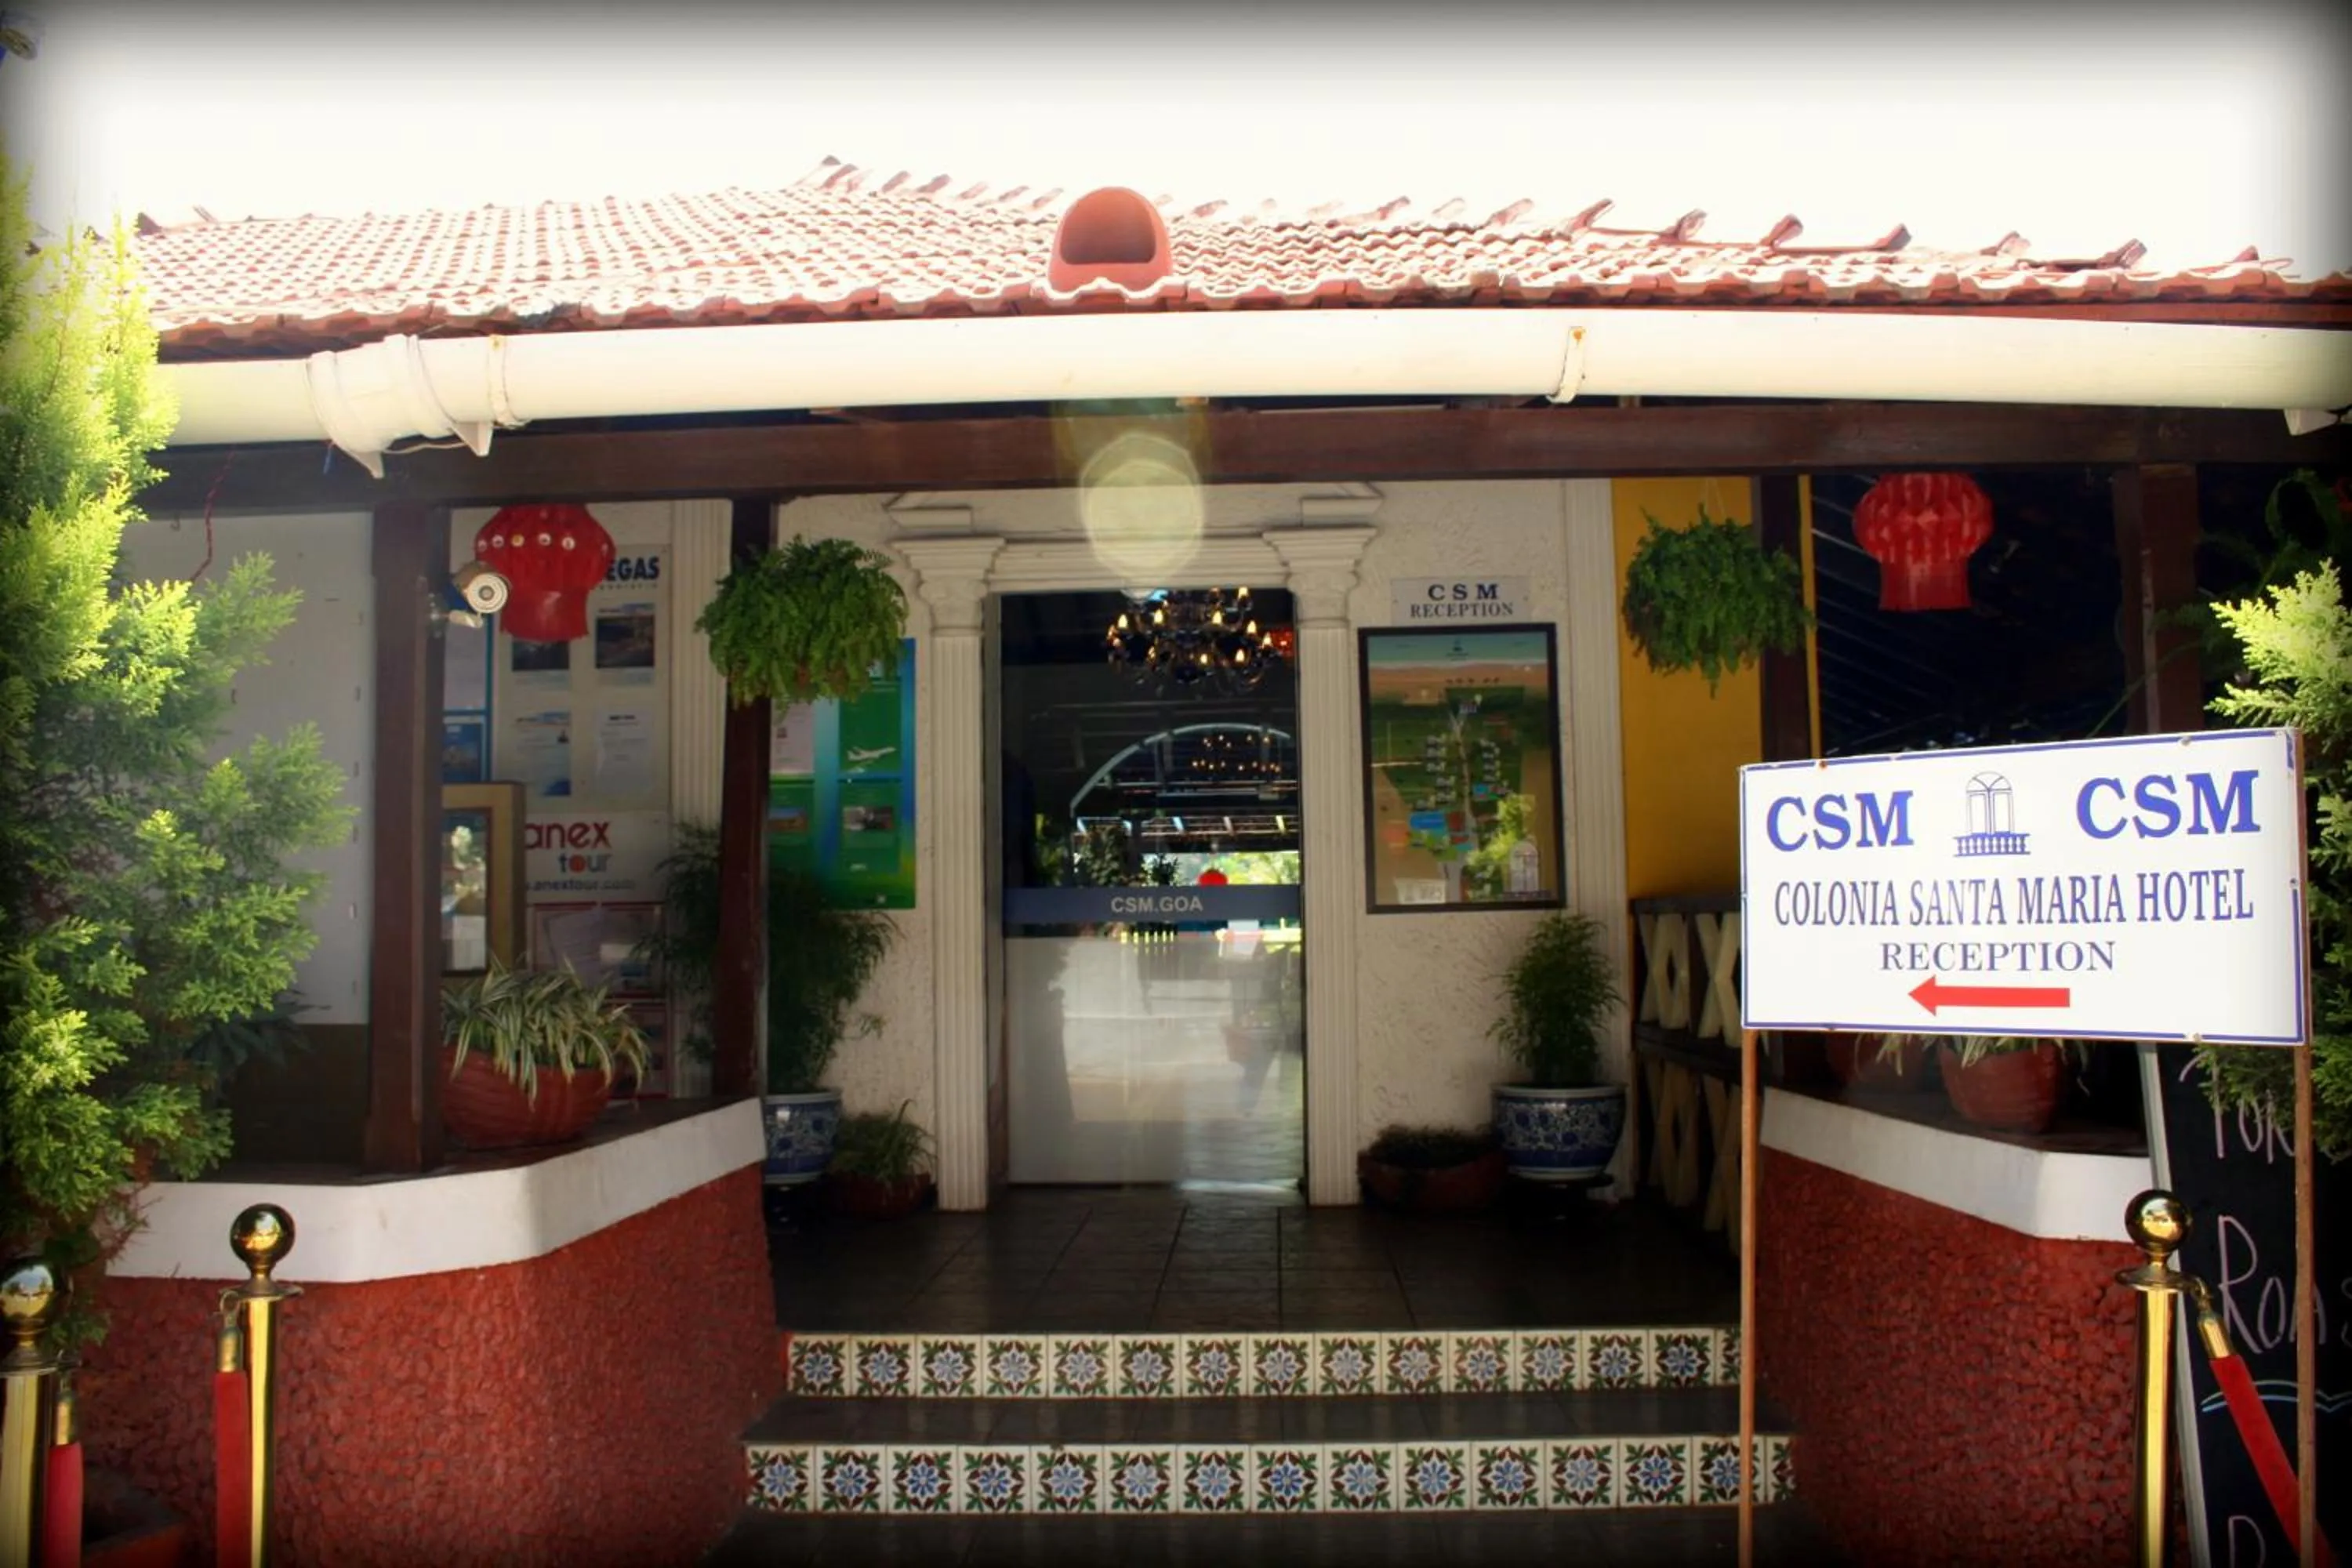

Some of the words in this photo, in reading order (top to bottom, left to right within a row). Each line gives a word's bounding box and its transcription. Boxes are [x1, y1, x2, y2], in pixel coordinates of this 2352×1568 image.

[1410, 602, 1514, 619] RECEPTION
[1767, 790, 1914, 852] CSM
[2076, 769, 2261, 840] CSM
[524, 821, 612, 850] anex
[557, 852, 612, 873] tour
[1775, 880, 1900, 926] COLONIA
[1910, 879, 2007, 926] SANTA
[2016, 874, 2126, 924] MARIA
[2137, 868, 2255, 922] HOTEL
[1880, 941, 2115, 972] RECEPTION
